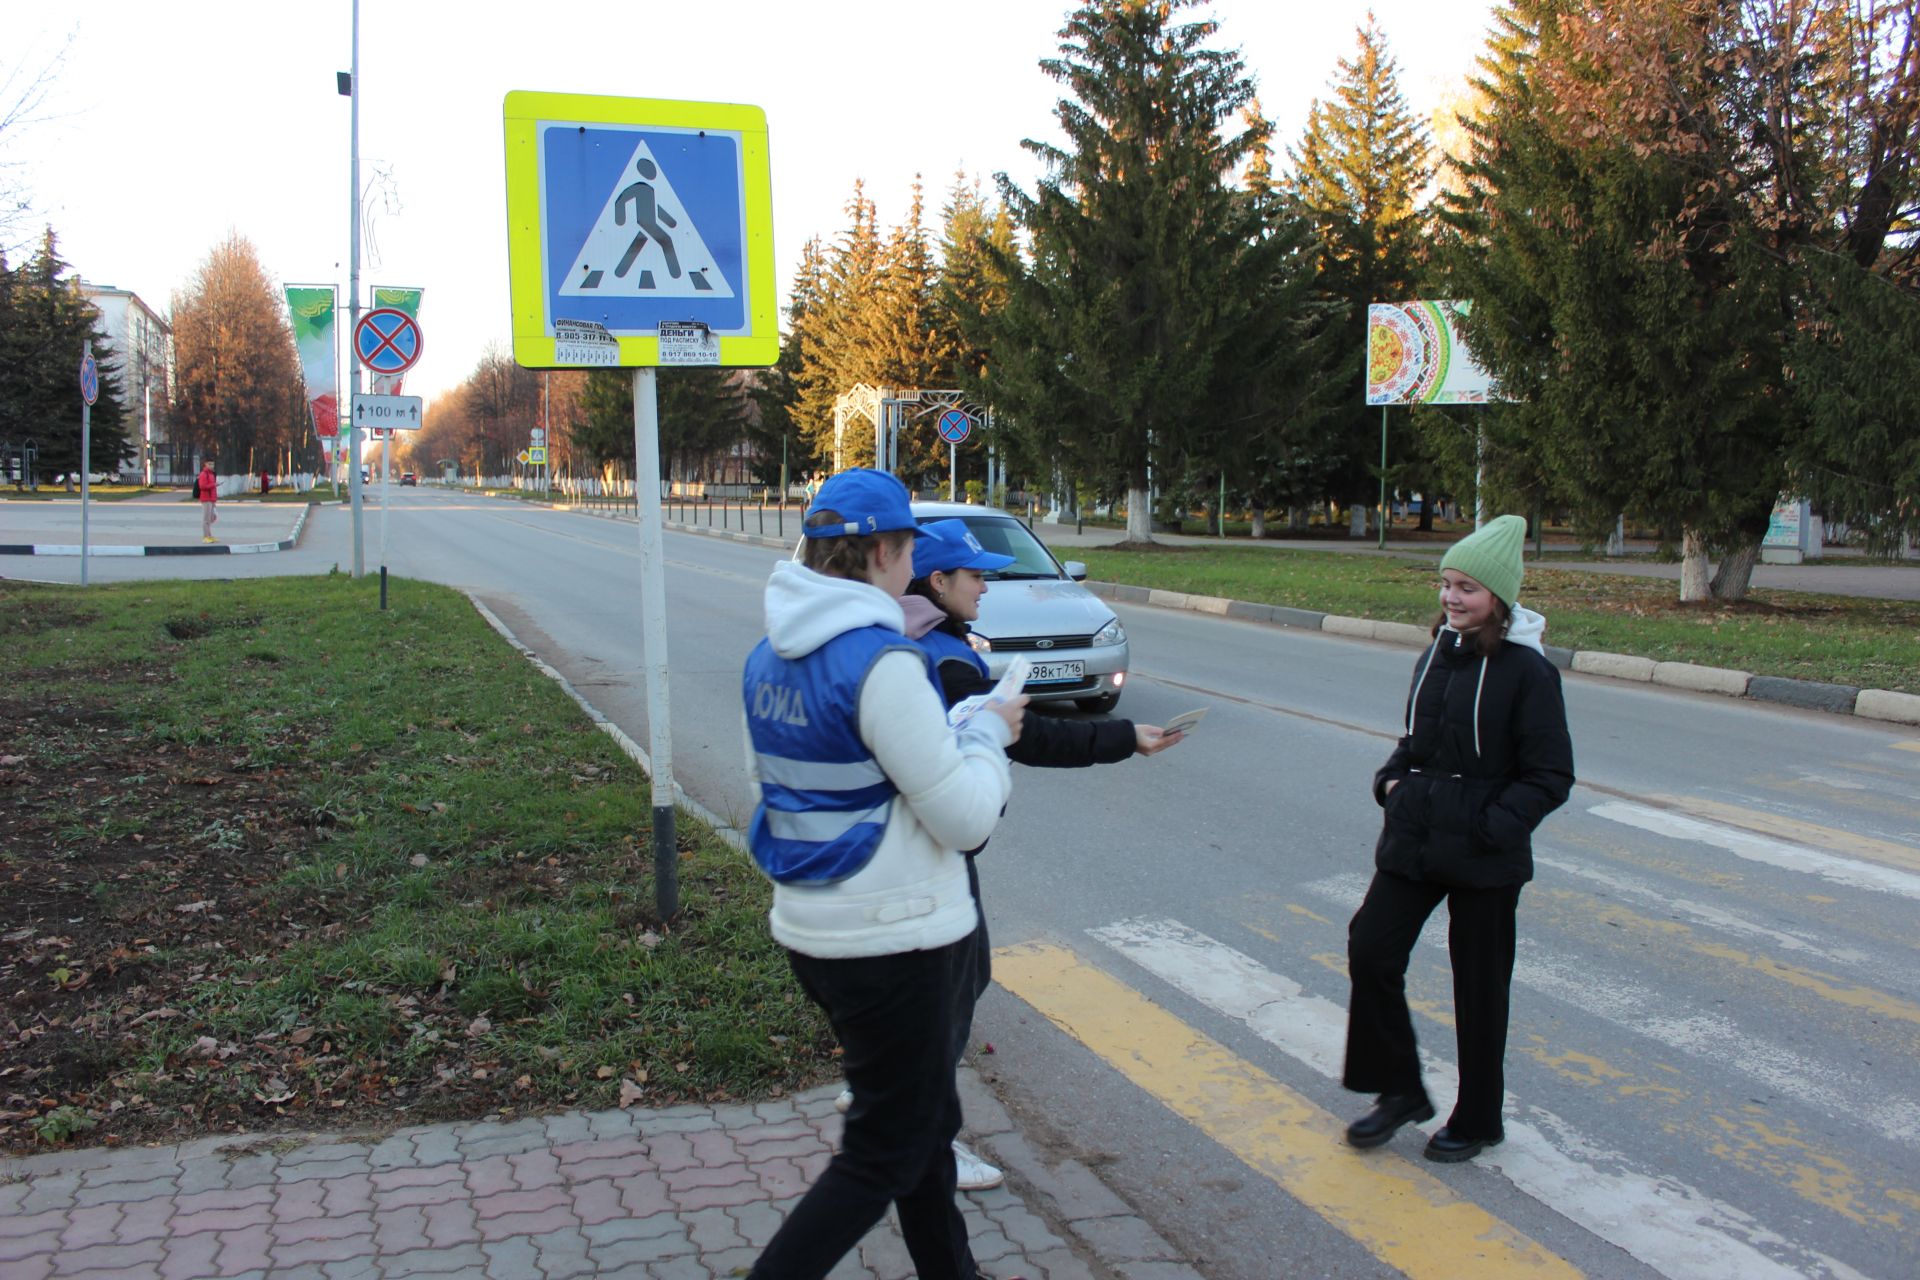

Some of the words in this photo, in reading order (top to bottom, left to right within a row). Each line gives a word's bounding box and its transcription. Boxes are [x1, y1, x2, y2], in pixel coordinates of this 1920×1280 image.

[557, 319, 594, 330] ФИНАНСОВАЯ
[660, 329, 694, 337] ДЕНЬГИ
[368, 405, 392, 417] 100
[1063, 662, 1082, 674] 716
[752, 682, 808, 727] ЮИД
